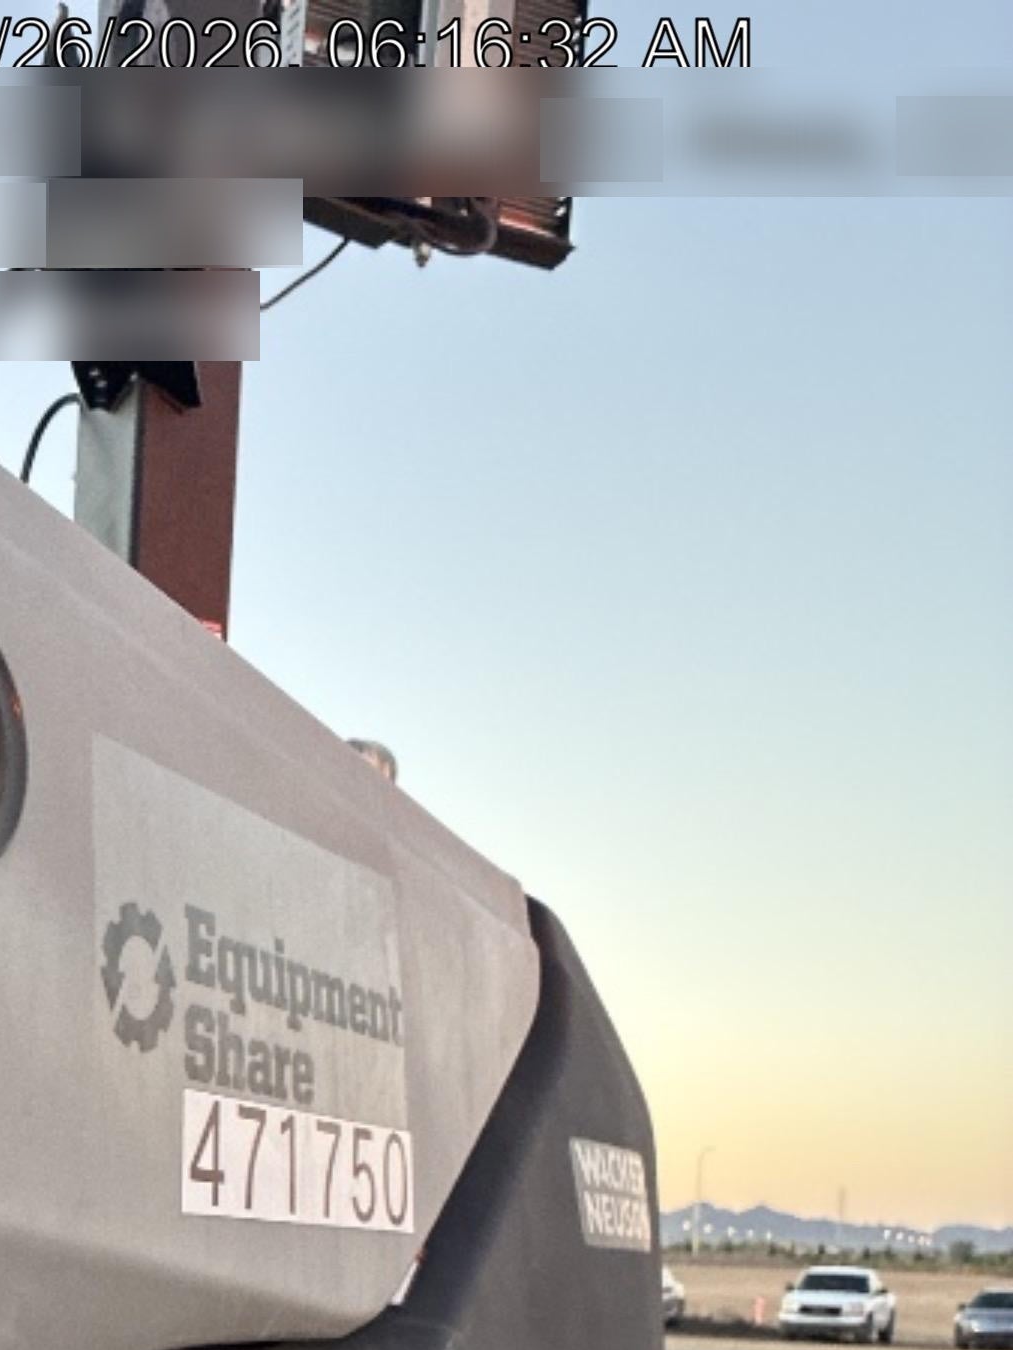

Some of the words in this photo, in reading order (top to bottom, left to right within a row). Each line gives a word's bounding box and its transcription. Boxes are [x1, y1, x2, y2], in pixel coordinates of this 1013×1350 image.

[184, 903, 403, 1047] Equipment
[184, 1003, 315, 1105] Share
[189, 1101, 408, 1226] 471750
